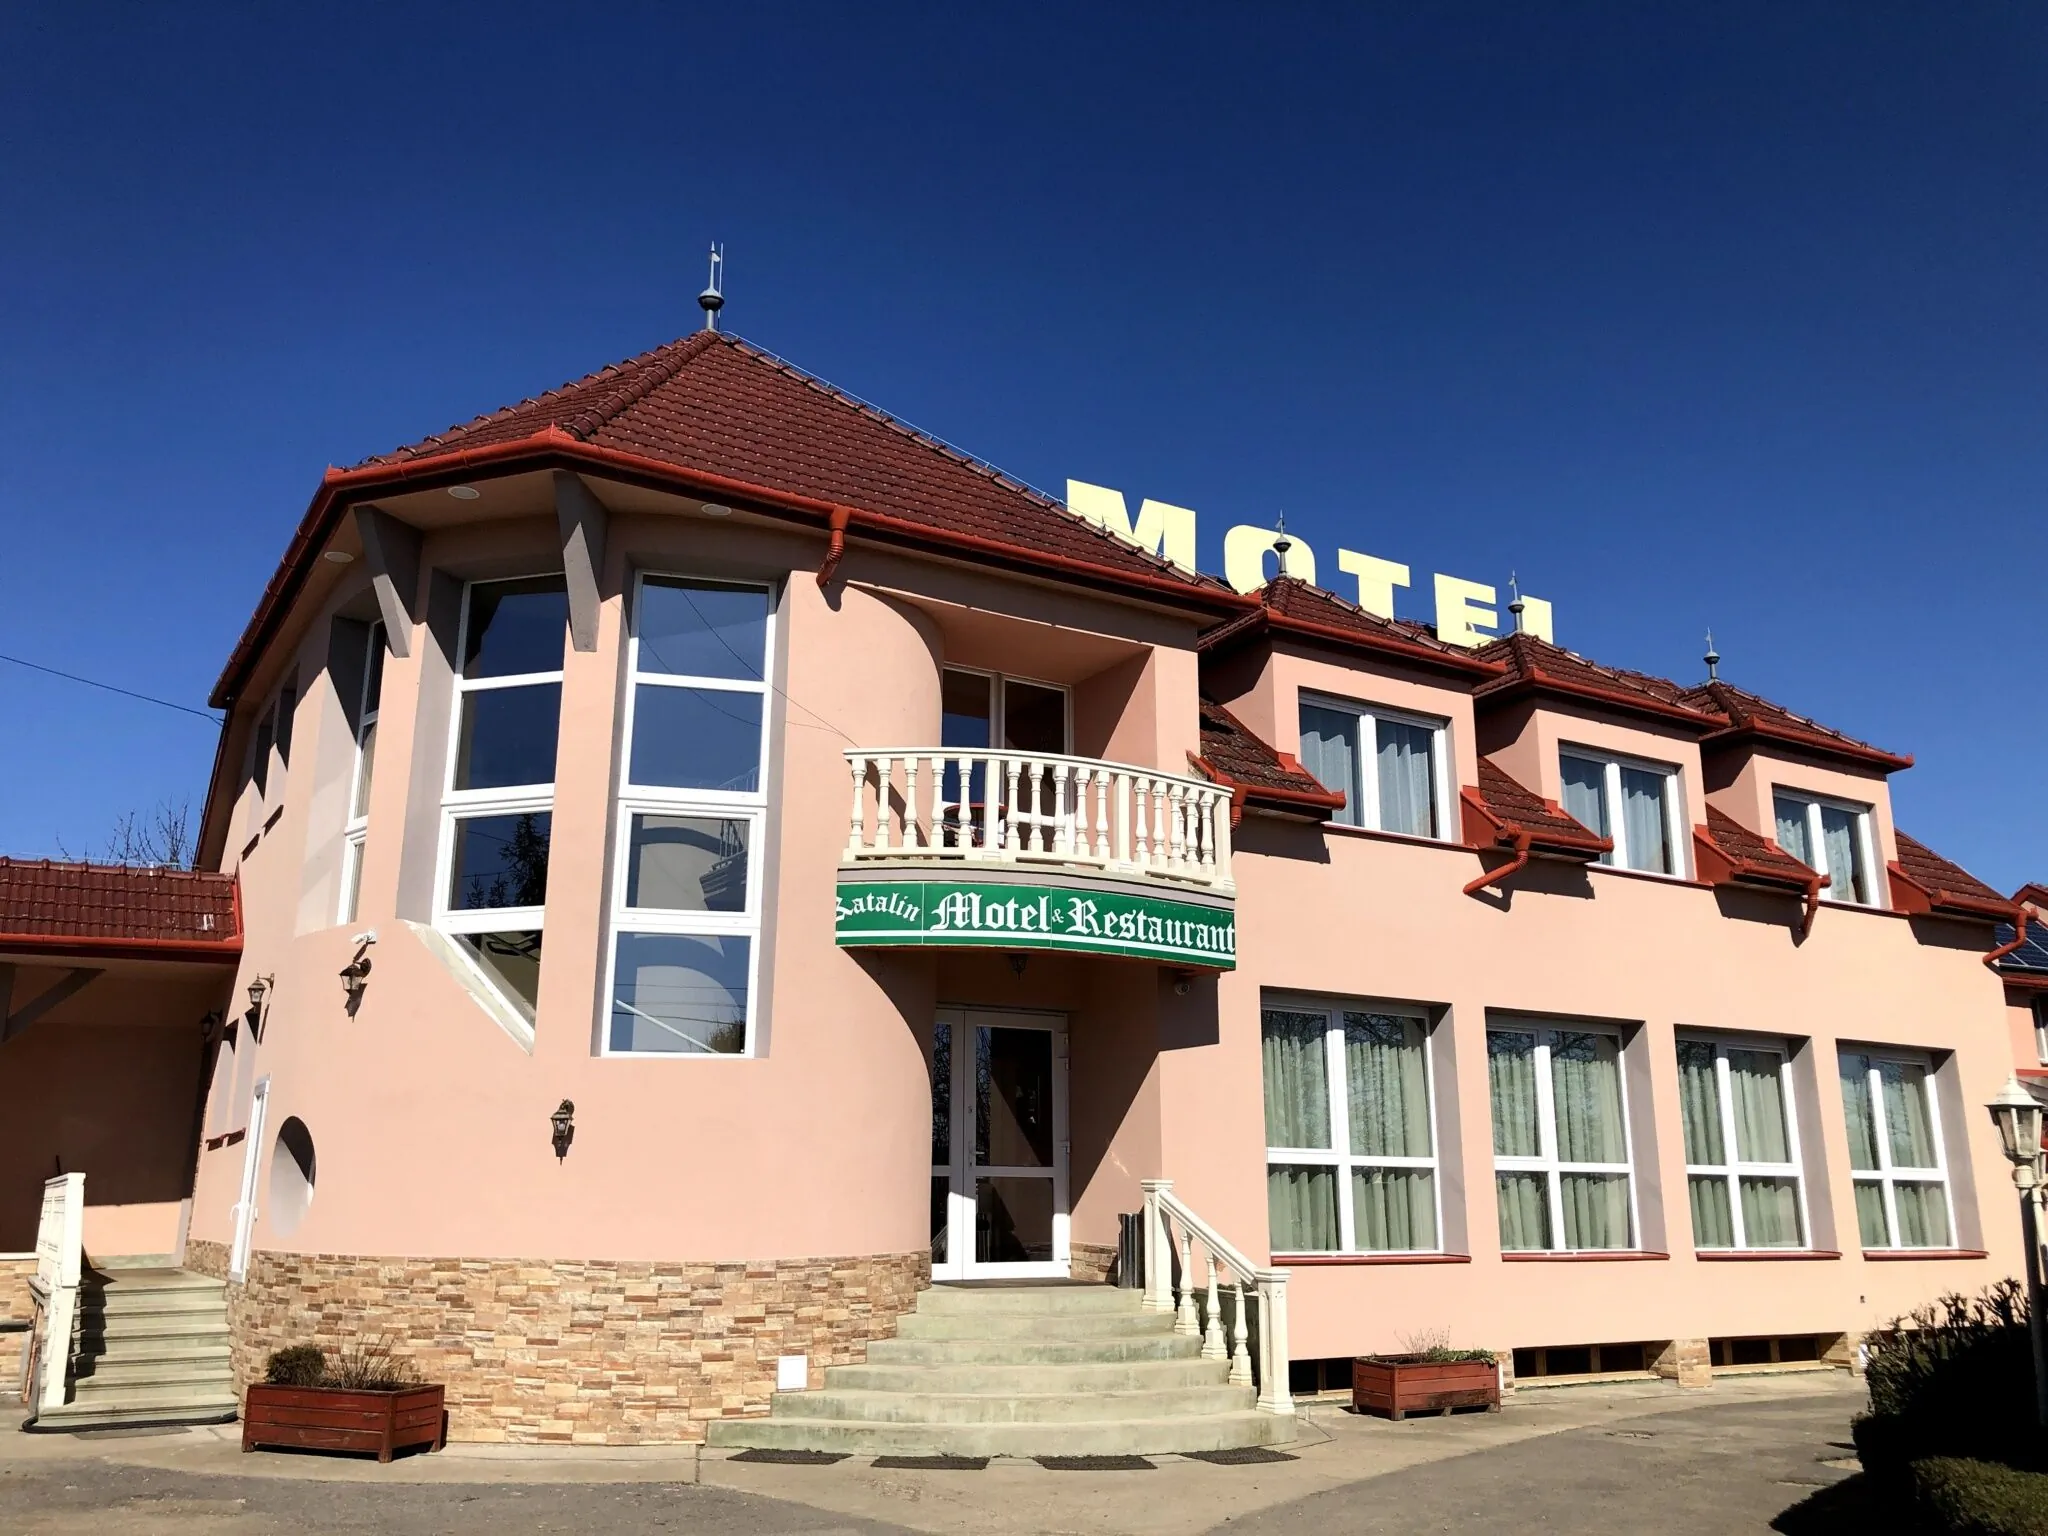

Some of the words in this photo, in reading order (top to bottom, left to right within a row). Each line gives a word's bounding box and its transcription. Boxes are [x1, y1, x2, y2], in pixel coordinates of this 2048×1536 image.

[930, 892, 1051, 932] Motel
[1052, 908, 1065, 924] &
[1065, 897, 1236, 953] Restaurant
